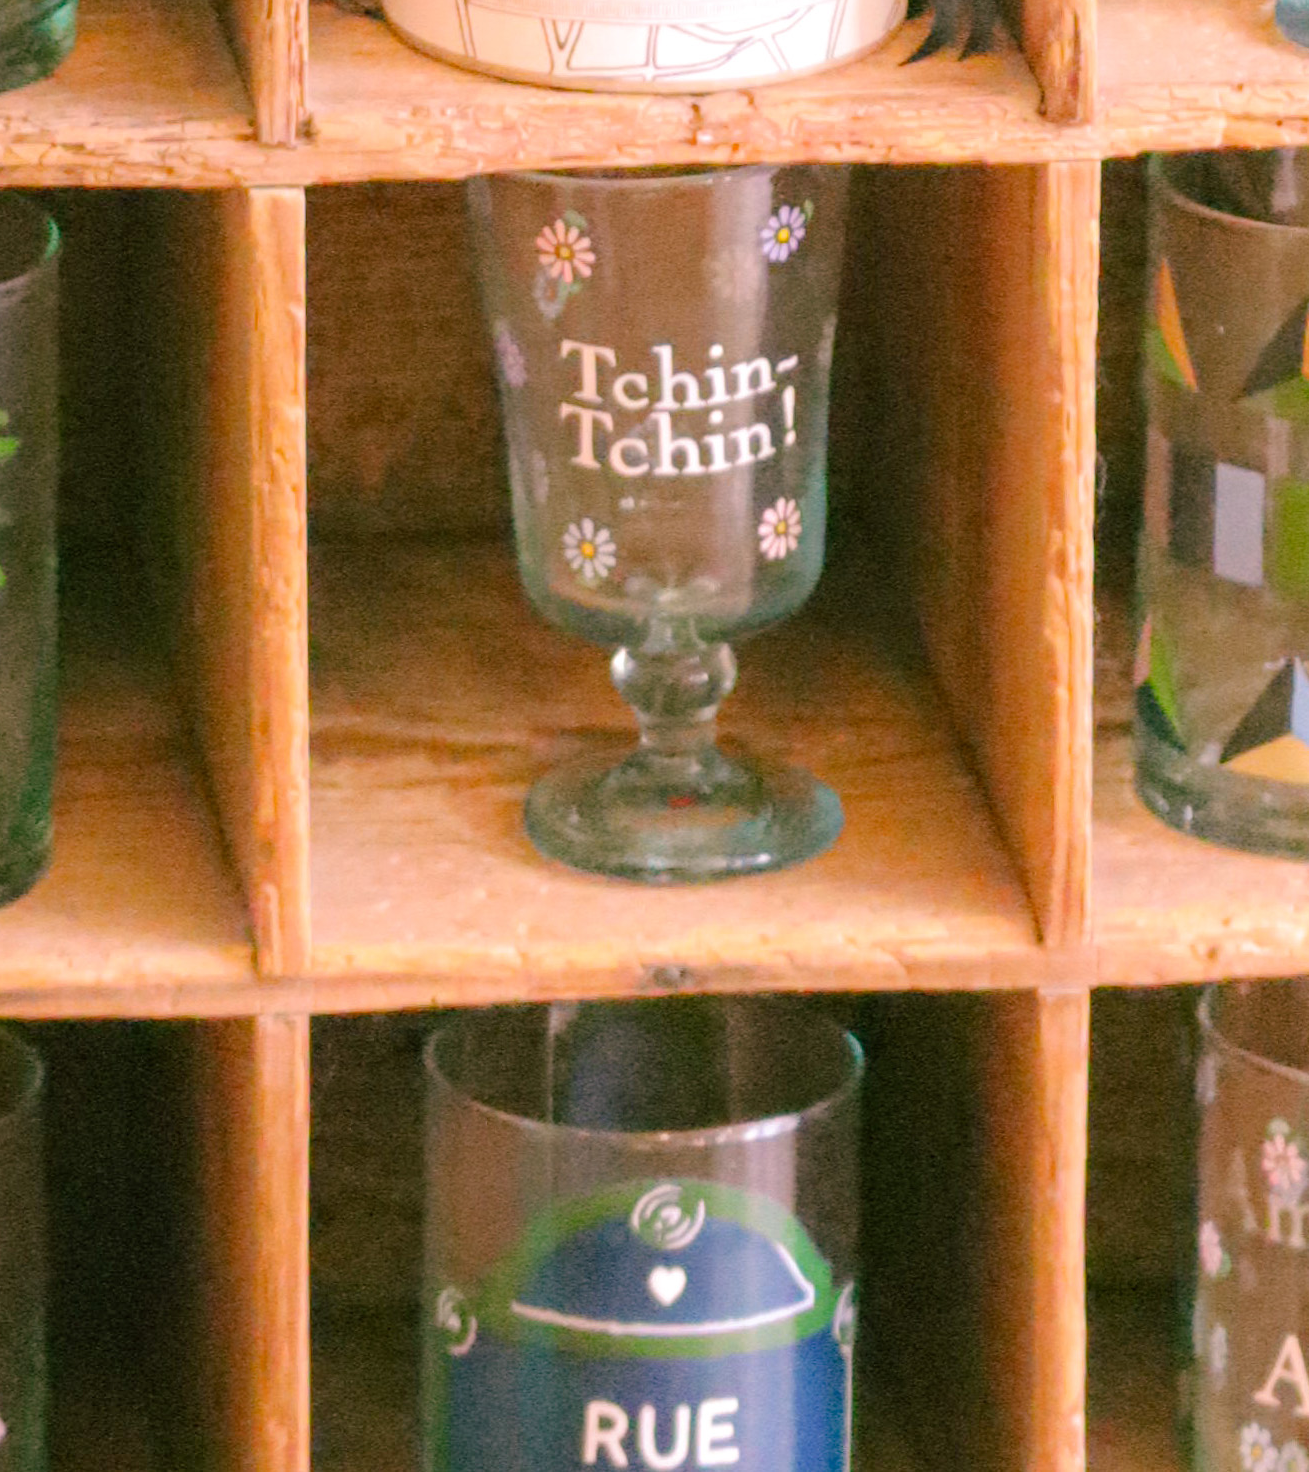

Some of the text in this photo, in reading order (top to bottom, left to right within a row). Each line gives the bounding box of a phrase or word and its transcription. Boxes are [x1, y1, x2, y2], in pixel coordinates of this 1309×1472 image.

[559, 338, 800, 415] Tchin-
[560, 385, 798, 478] Tchin!
[582, 1396, 741, 1471] RUE
